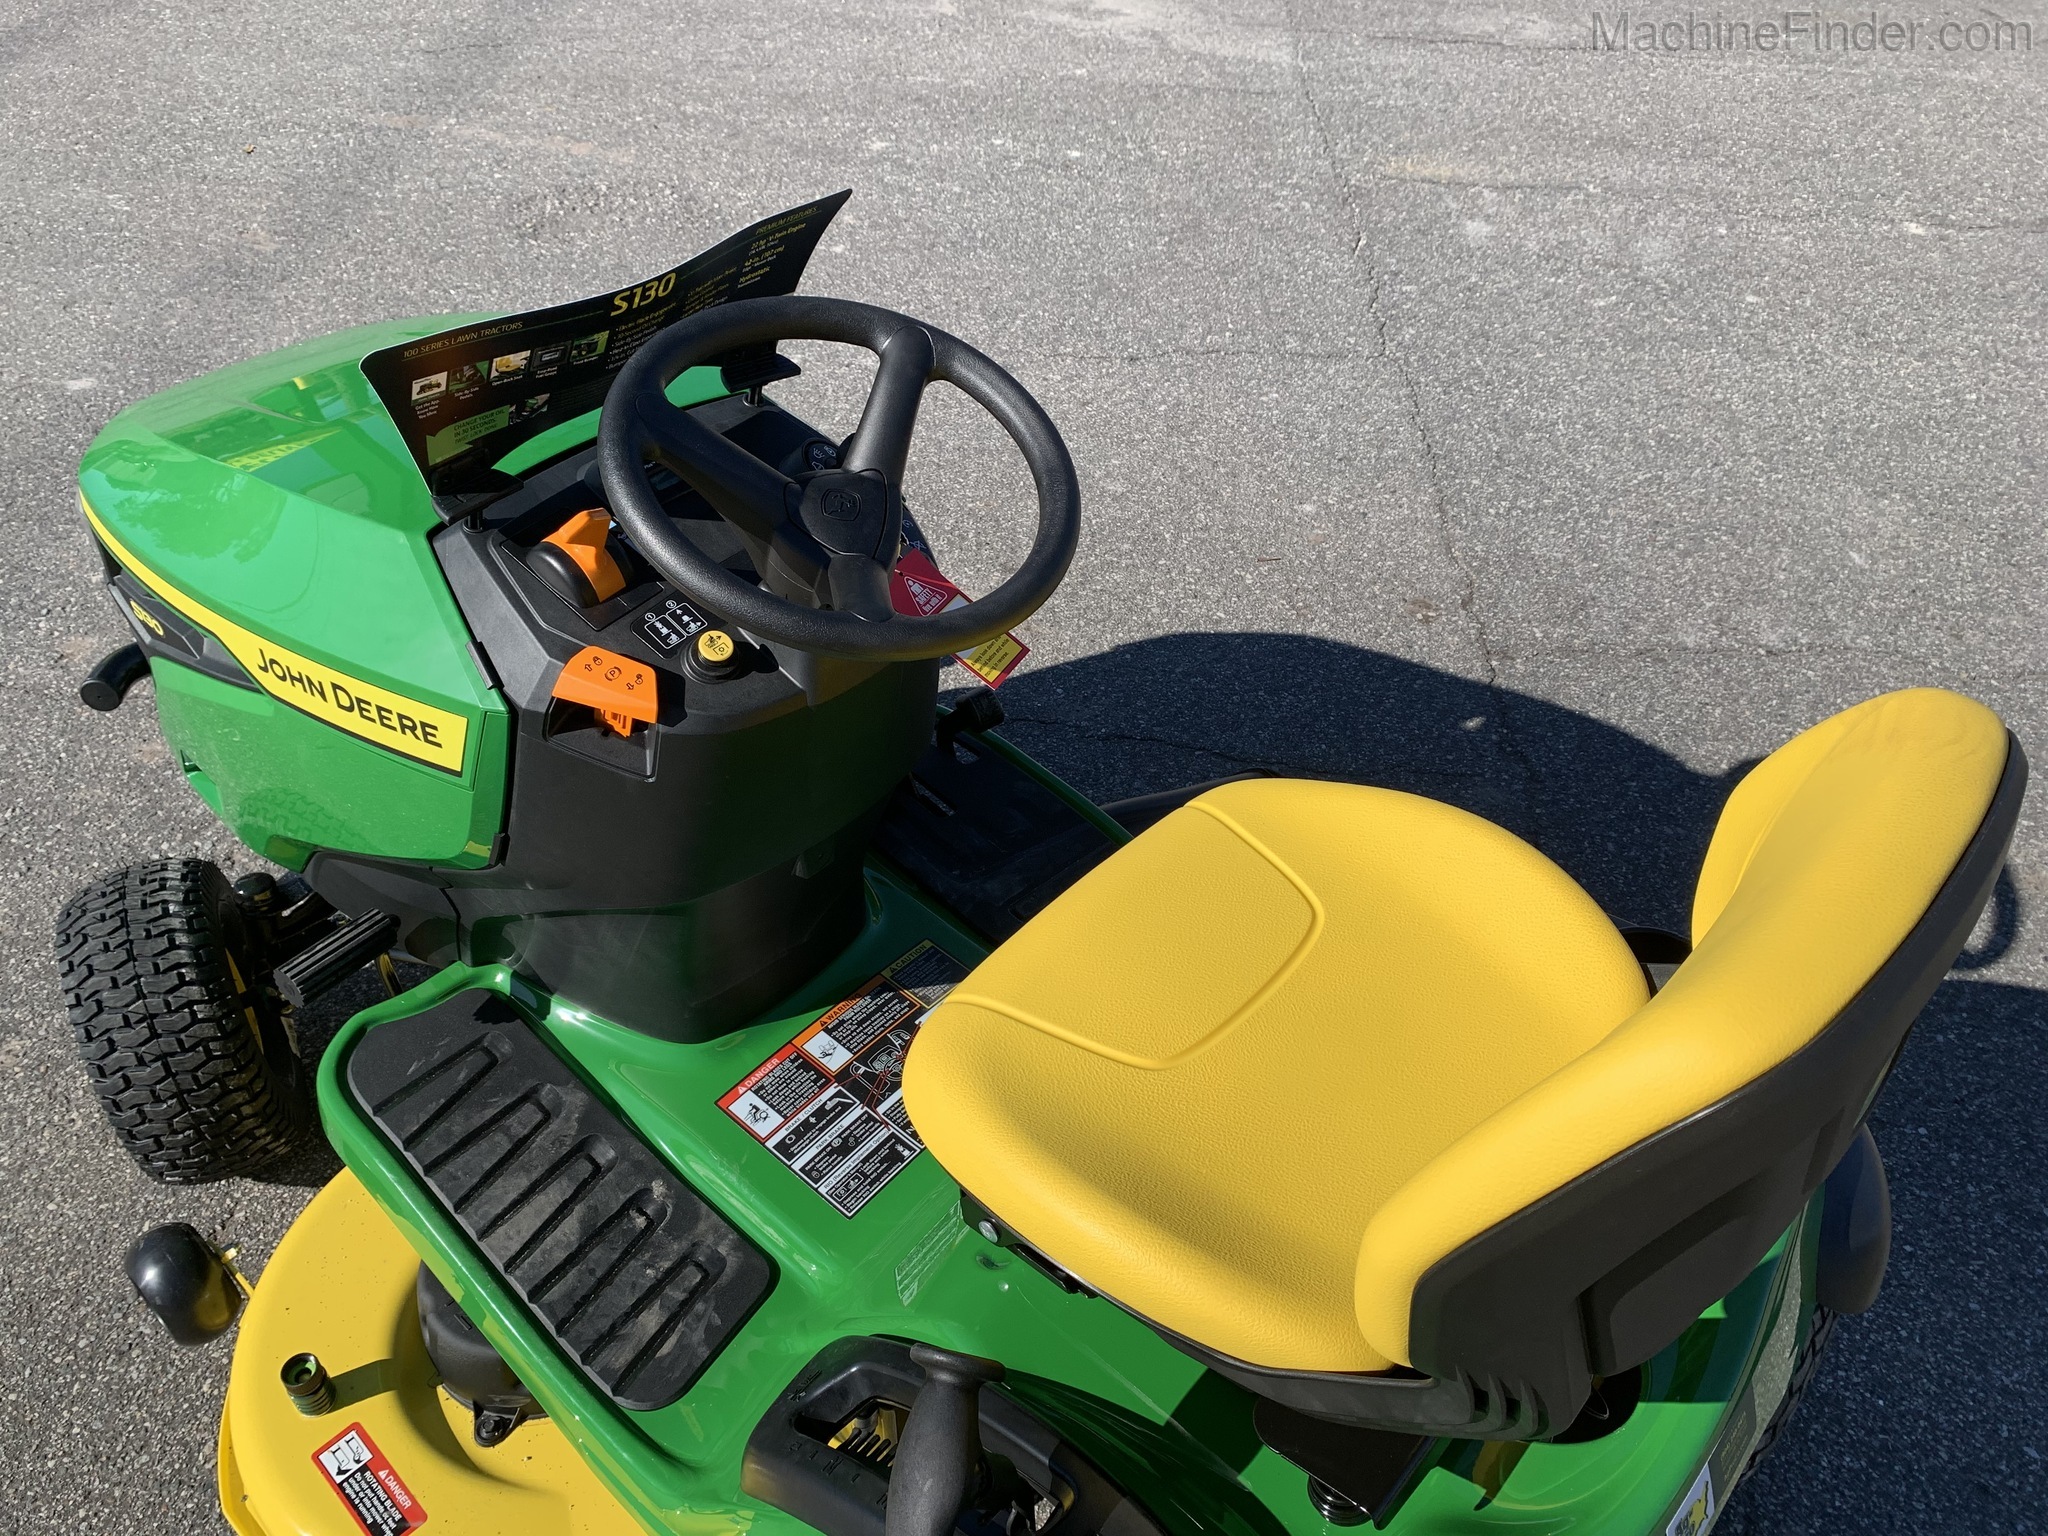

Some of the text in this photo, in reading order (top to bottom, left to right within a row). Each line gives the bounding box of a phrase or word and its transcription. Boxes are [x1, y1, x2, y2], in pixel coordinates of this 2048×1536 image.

[755, 206, 818, 235] PREMIUM FEATURES
[610, 272, 677, 317] S130
[404, 321, 524, 358] 100 SERIES LAWN TRACTORS
[454, 417, 477, 431] CHANGE
[479, 411, 495, 421] YOUR
[454, 430, 461, 438] IN
[915, 587, 932, 604] SAFETY
[130, 600, 164, 636] S130
[257, 648, 443, 749] JOHN DEERE
[895, 944, 926, 967] CAUTION
[825, 993, 862, 1022] WARNING
[743, 1058, 780, 1086] DANGER
[785, 1117, 800, 1131] BRAKE
[804, 1099, 822, 1114] CLUTCH
[816, 1124, 843, 1149] PARK BRAKE
[824, 1130, 887, 1188] RIO (Reverse Implement Option)
[341, 1481, 356, 1499] engine
[356, 1502, 373, 1523] running
[348, 1477, 360, 1492] under
[362, 1496, 372, 1508] into
[369, 1507, 383, 1524] mower
[353, 1472, 396, 1529] Do not put hands or feet
[363, 1470, 402, 1520] ROTATING BLADE
[384, 1475, 411, 1508] DANGER
